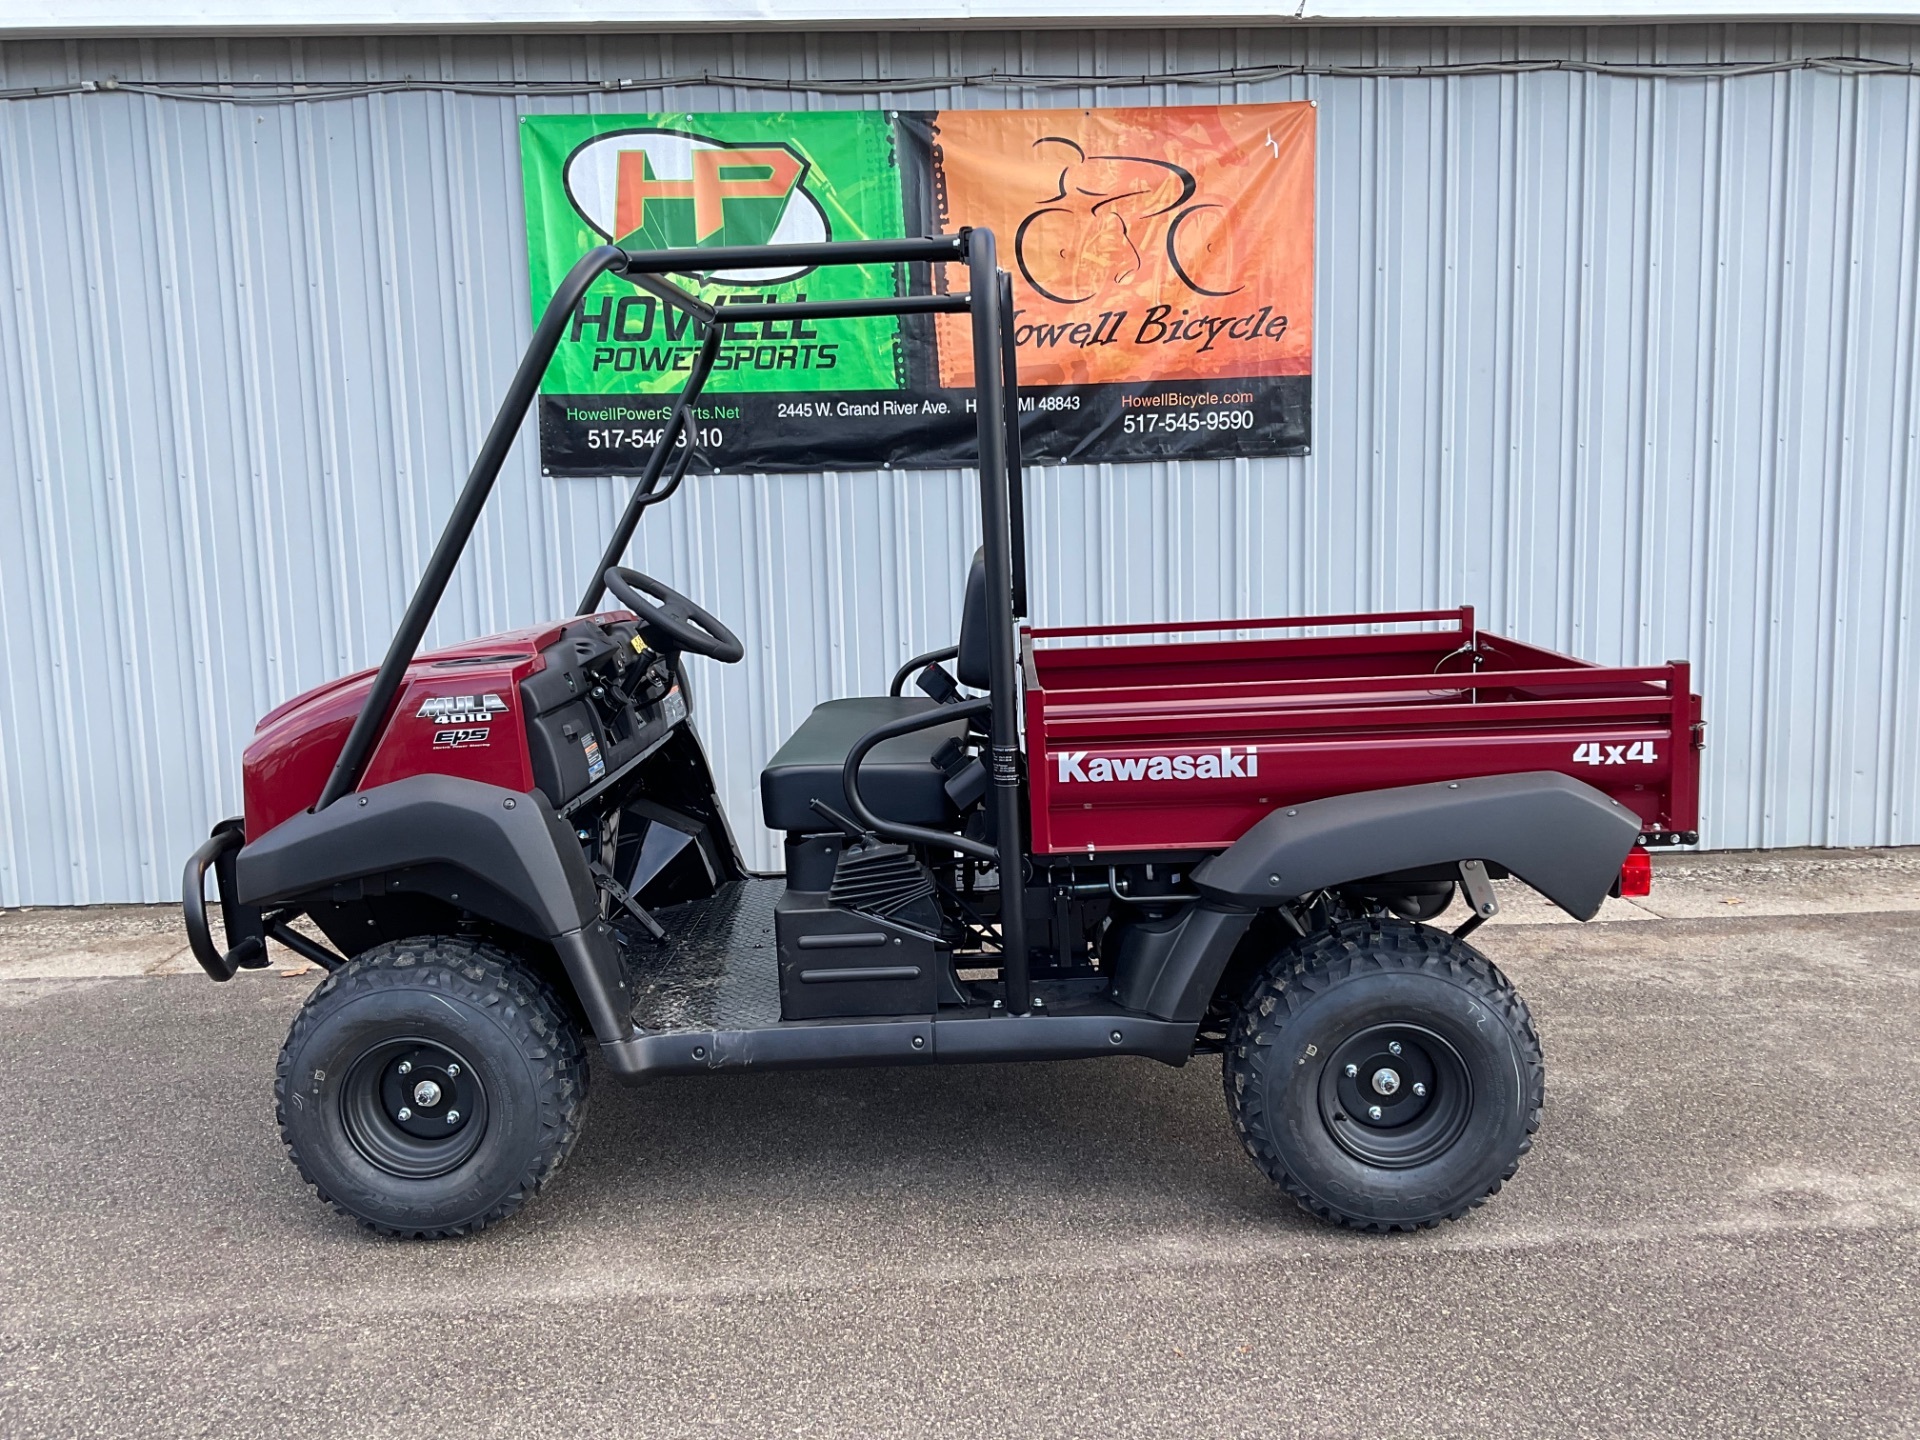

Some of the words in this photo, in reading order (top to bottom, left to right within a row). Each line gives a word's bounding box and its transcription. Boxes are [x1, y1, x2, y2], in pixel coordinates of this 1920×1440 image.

[613, 148, 804, 244] HP
[1014, 309, 1128, 349] owell
[1134, 304, 1288, 353] Bicycle
[592, 344, 839, 372] POWESPORTS
[777, 402, 813, 418] 2445
[814, 402, 833, 417] W.
[836, 401, 880, 417] Grand
[883, 400, 919, 415] River
[921, 400, 951, 415] Ave.
[1018, 397, 1035, 412] MI
[1038, 396, 1081, 411] 48843
[1121, 392, 1254, 408] HowellBicycle.com
[566, 406, 740, 421] HowellPowerSrts.Net
[1123, 410, 1254, 433] 517-545-9590
[416, 694, 509, 718] MULE
[434, 713, 493, 725] 4010
[1057, 746, 1258, 783] Kawasaki
[1572, 741, 1658, 765] 4x4
